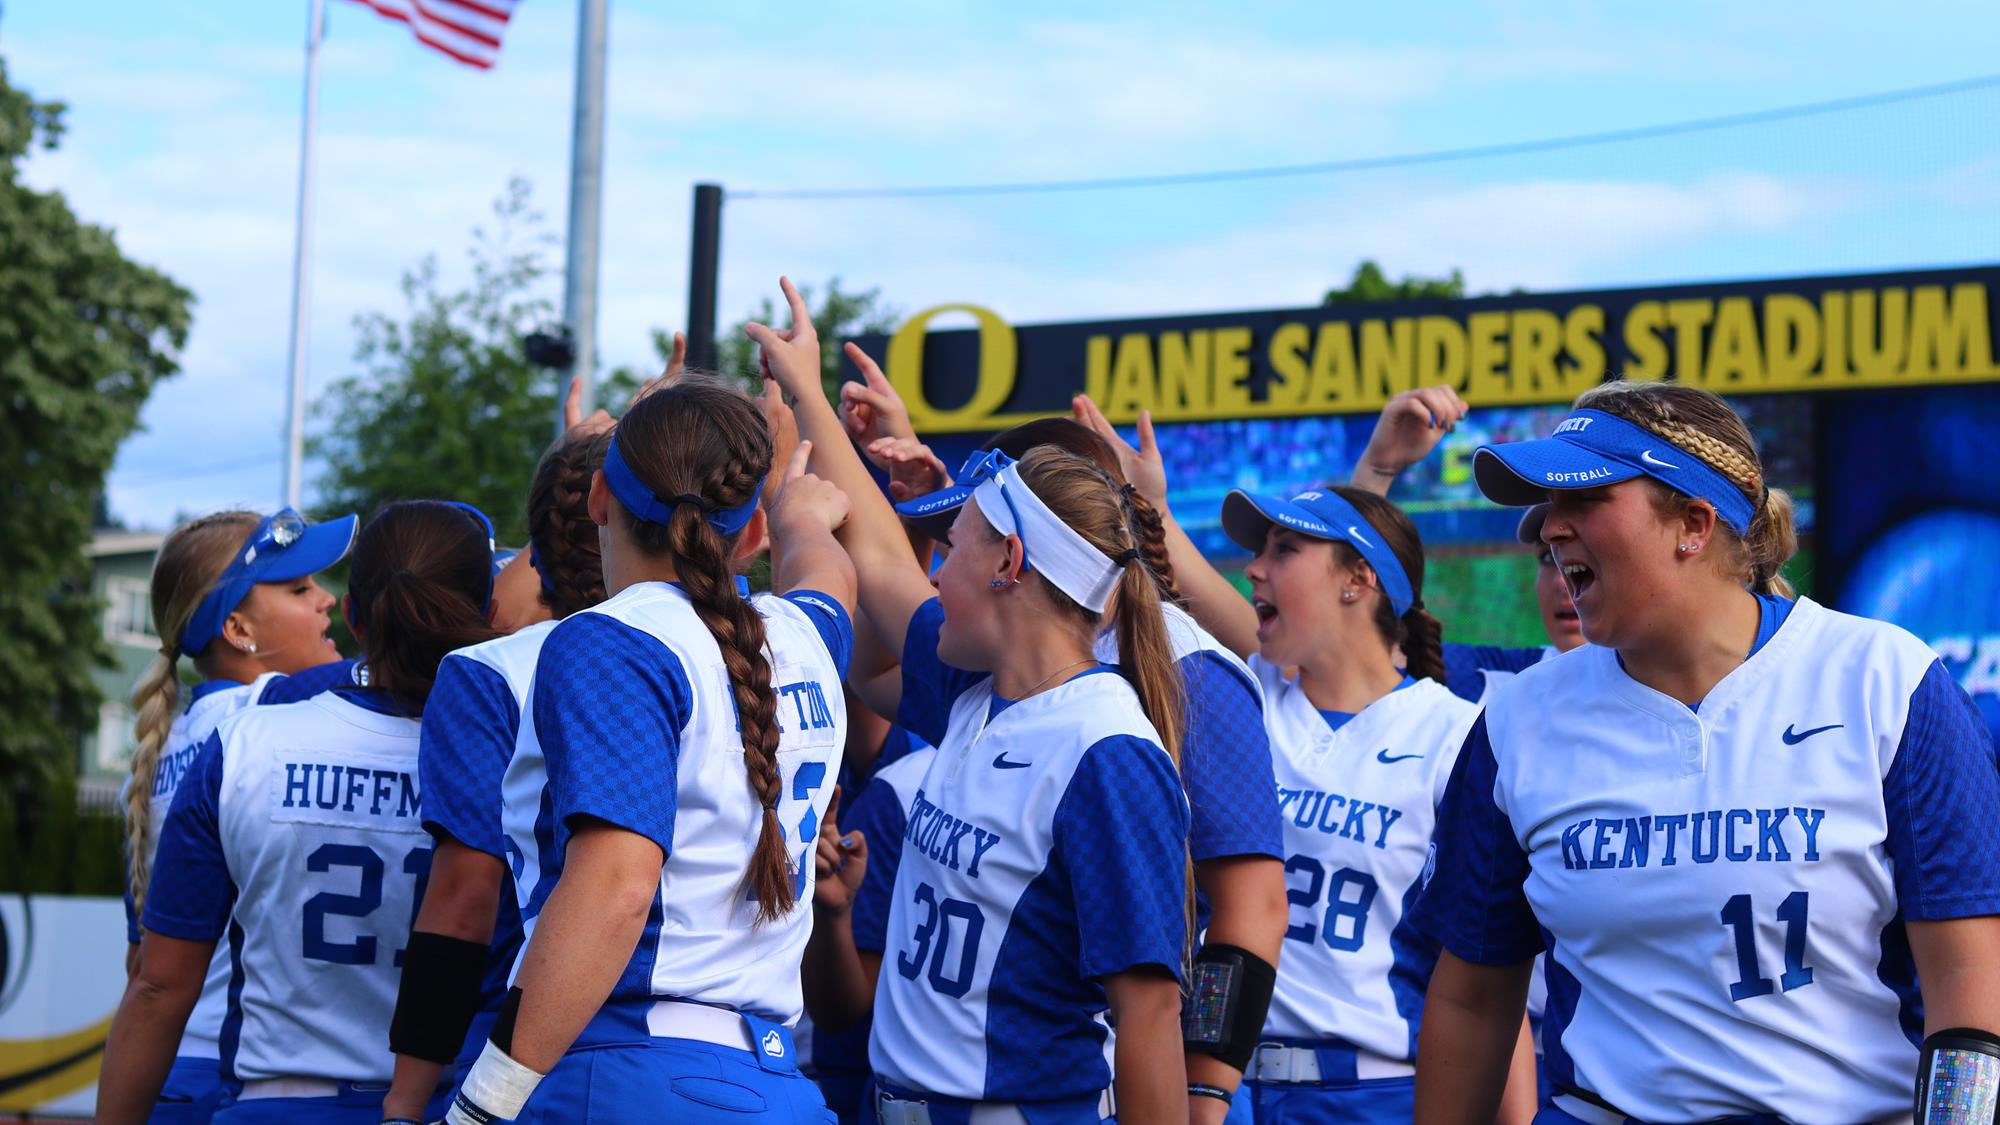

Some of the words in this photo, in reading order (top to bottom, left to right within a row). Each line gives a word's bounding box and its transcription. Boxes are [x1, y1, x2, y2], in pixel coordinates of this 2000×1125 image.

[1082, 325, 1251, 418] JANE
[1267, 304, 1606, 405] SANDERS
[1622, 281, 1991, 386] STADIUM
[917, 492, 967, 512] SOFTBALL
[1546, 466, 1613, 482] SOFTBALL
[1278, 513, 1328, 533] SOFTBALL
[1560, 806, 1826, 871] KENTUCKY
[897, 881, 986, 1000] 30
[1284, 853, 1379, 953] 28
[1720, 891, 1814, 1001] 11
